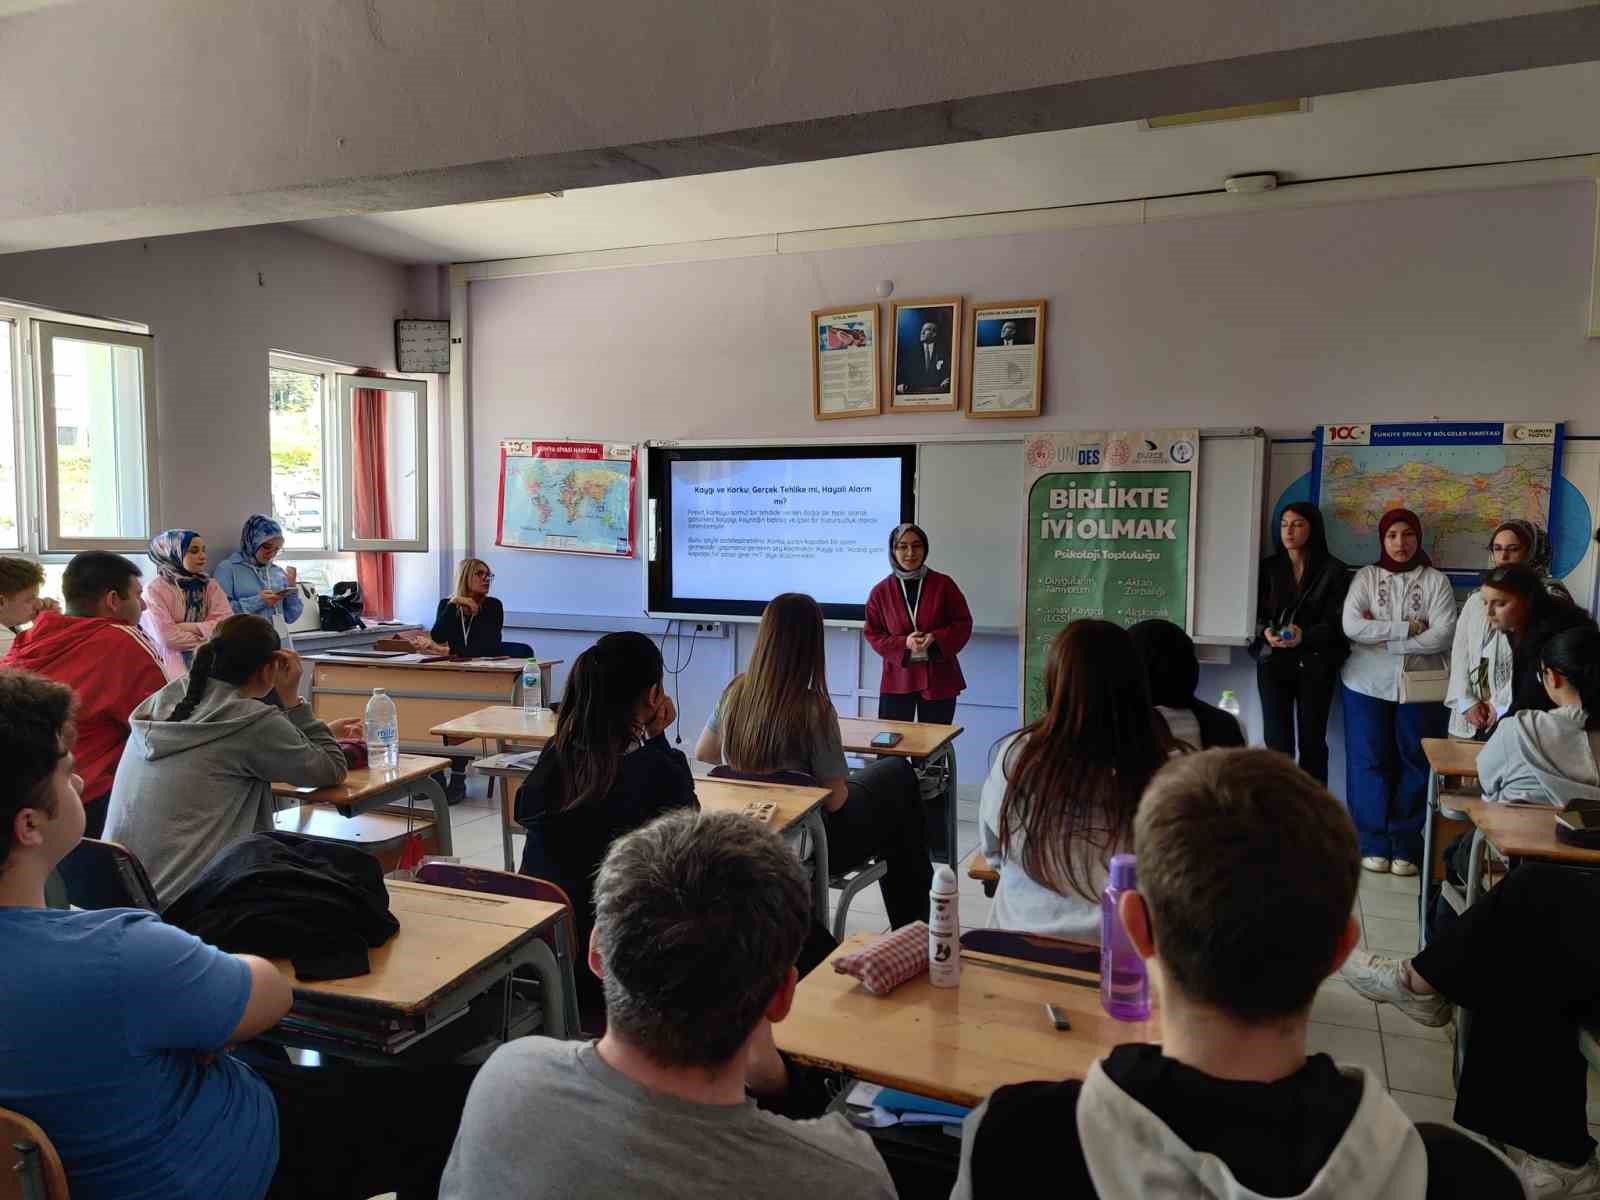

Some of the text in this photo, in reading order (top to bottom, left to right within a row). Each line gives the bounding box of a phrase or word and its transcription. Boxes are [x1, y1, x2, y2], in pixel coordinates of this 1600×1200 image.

[694, 486, 715, 496] Kaygı
[752, 485, 778, 496] Gerçek
[779, 486, 807, 494] Tehlike
[822, 486, 847, 496] Hayali
[848, 485, 872, 494] Alarm
[1050, 480, 1169, 509] BİRLİKTE
[1040, 511, 1177, 540] İYİ OLMAK
[1054, 549, 1161, 562] Psikoloji Topluluğu
